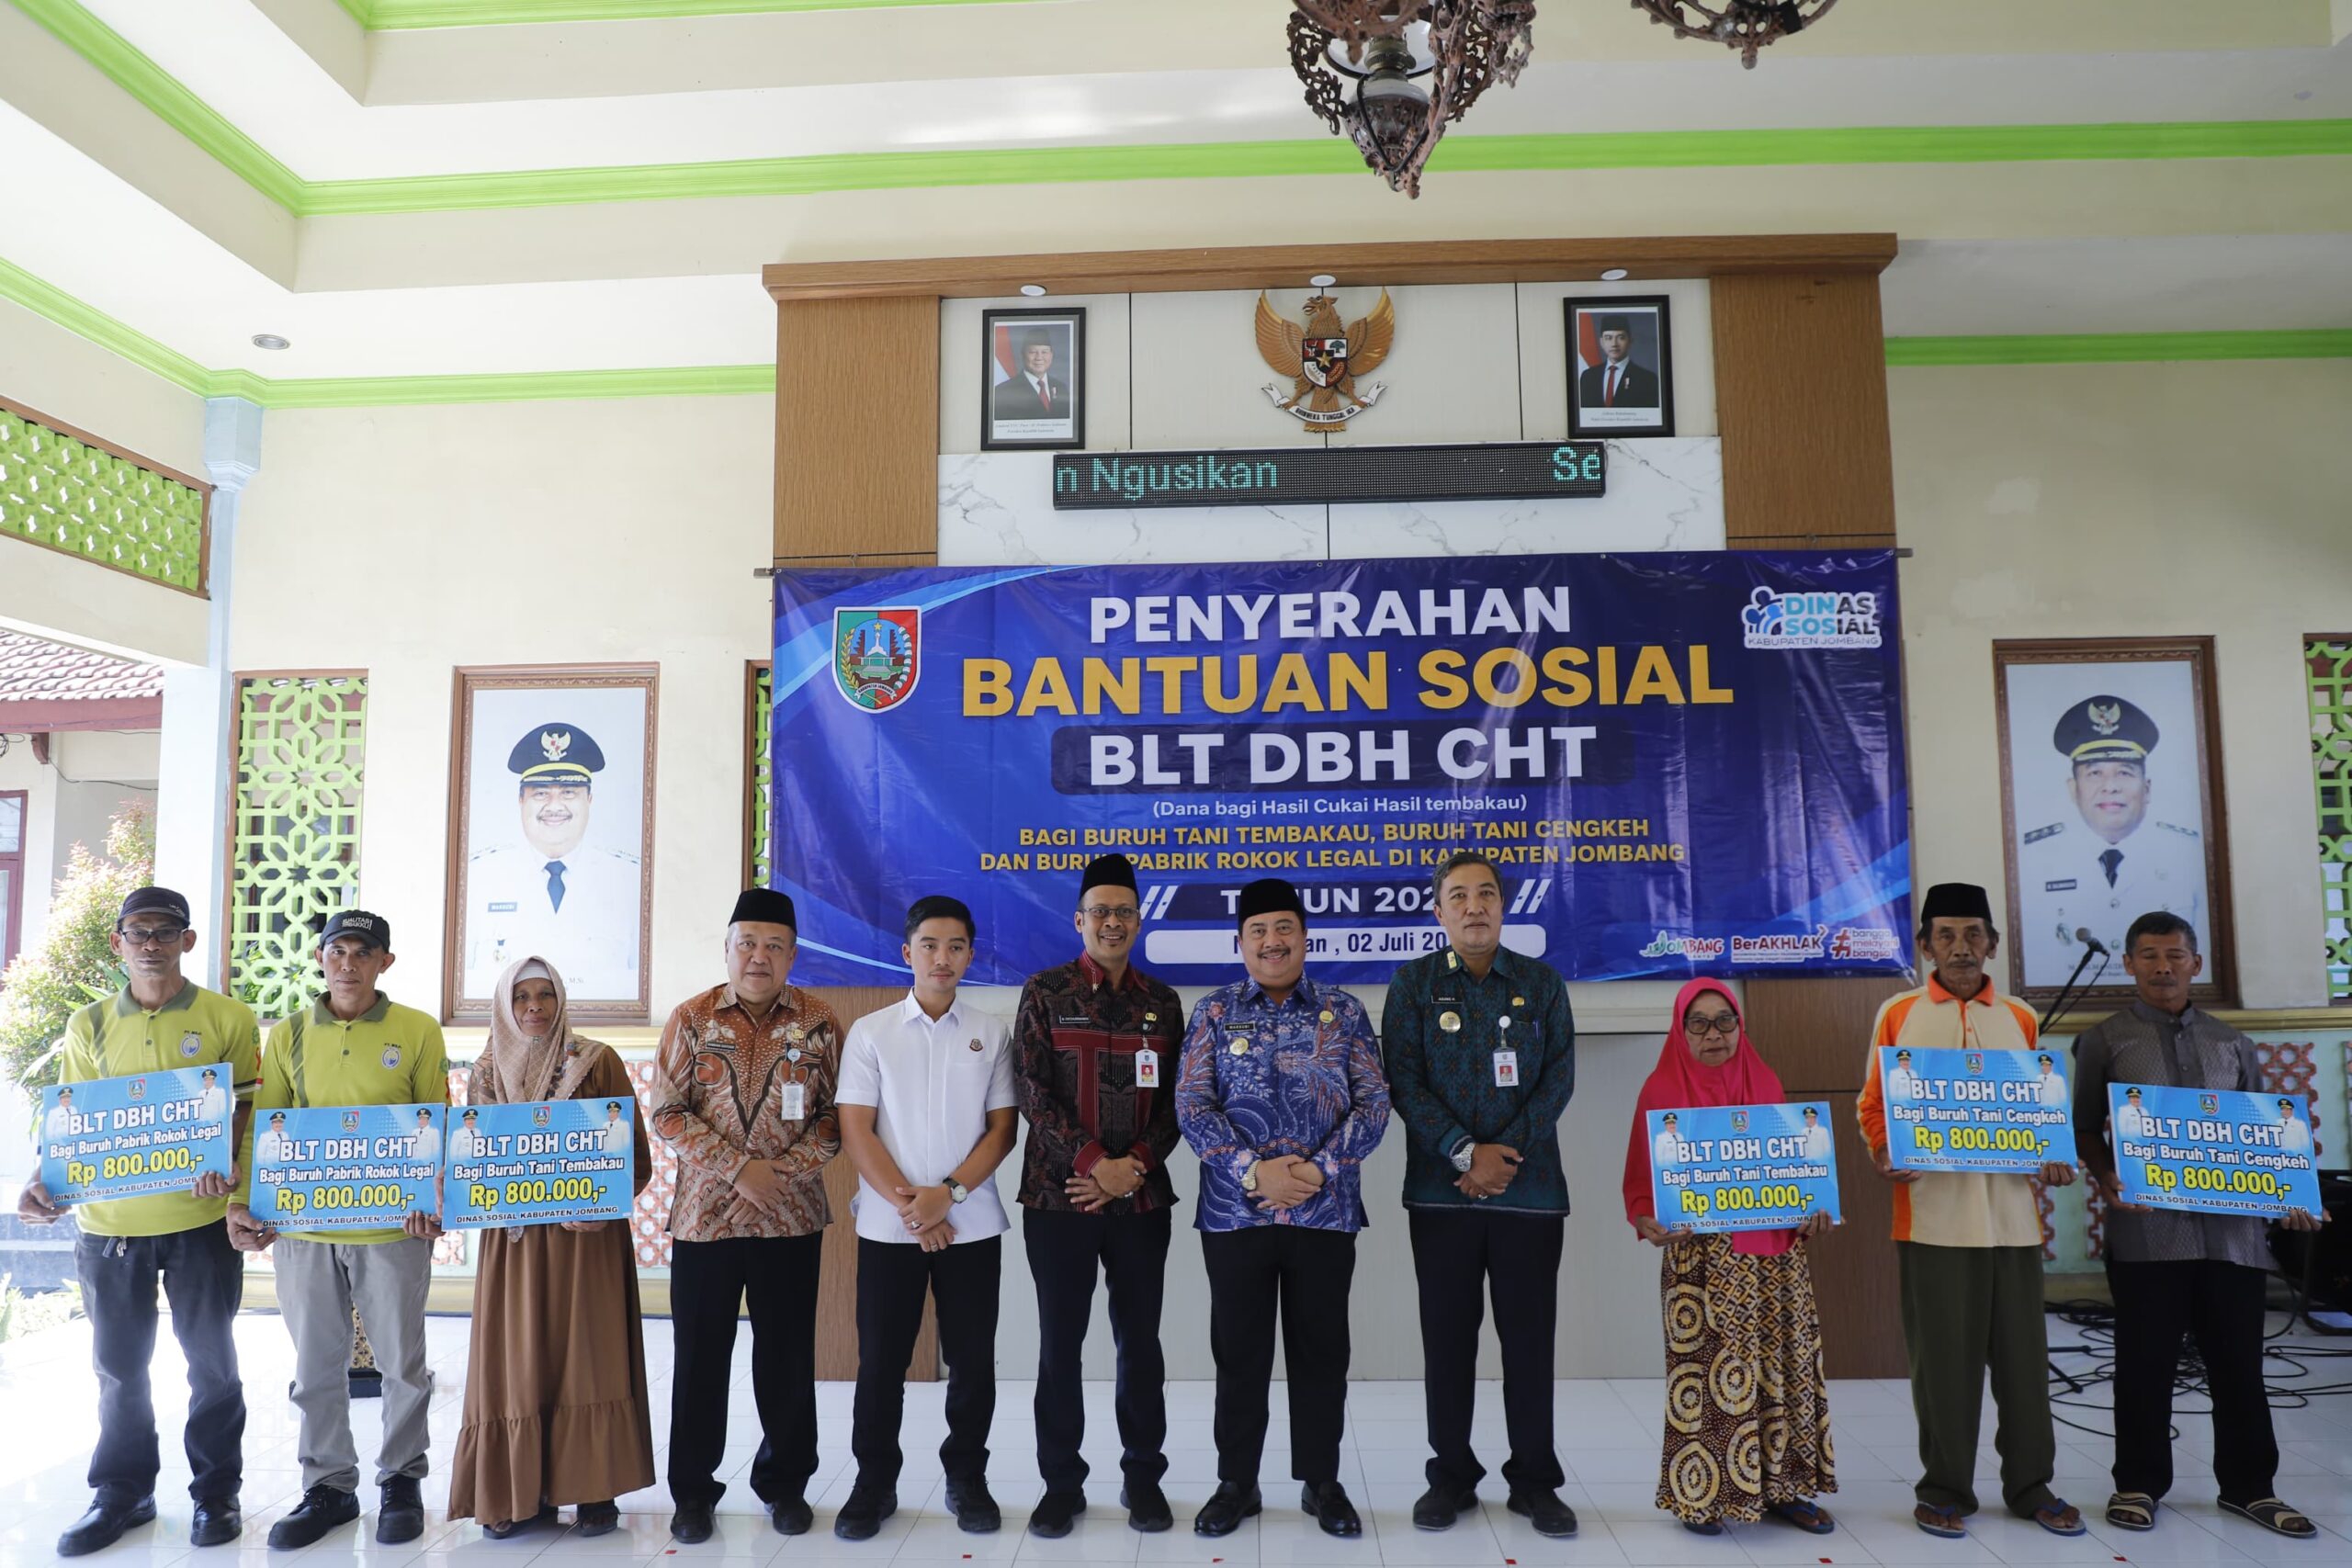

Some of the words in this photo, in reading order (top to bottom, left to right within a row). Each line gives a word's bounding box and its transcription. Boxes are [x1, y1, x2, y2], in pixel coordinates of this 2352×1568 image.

[1093, 455, 1278, 501] Ngusikan
[1091, 586, 1571, 643] PENYERAHAN
[1785, 596, 1872, 615] DINAS
[1785, 617, 1876, 636] SOSIAL
[1748, 637, 1818, 647] KABUPATEN
[1821, 637, 1879, 646] JOMBANG
[963, 650, 1388, 717] BANTUAN
[1418, 645, 1735, 709] SOSIAL
[1091, 733, 1225, 785] BLT
[1250, 729, 1410, 784] DBH
[1437, 726, 1597, 780] CHT
[1153, 801, 1210, 818] (Dana
[1216, 800, 1257, 818] bagi
[1262, 798, 1309, 815] Hasil
[1314, 797, 1369, 814] Cukai
[1374, 795, 1420, 813] Hasil
[1425, 795, 1527, 812] tembakau)
[1020, 829, 1076, 846] BAGI
[1084, 828, 1166, 845] BURUH
[1174, 827, 1228, 844] TANI
[1236, 824, 1376, 844] TEMBAKAU,
[1384, 822, 1465, 841] BURUH
[1472, 821, 1528, 840] TANI
[1534, 819, 1649, 838] CENGKEH
[980, 853, 1029, 871] DAN
[1217, 852, 1298, 869] ROKOK
[1306, 849, 1381, 868] LEGAL
[1389, 848, 1411, 866] DI
[1566, 843, 1684, 863] JOMBANG
[1220, 887, 1360, 914] TUN
[1348, 933, 1373, 953] 02
[1379, 931, 1414, 952] Juli
[1733, 937, 1822, 950] BerAKHLAK
[1910, 1078, 1947, 1100] BLT
[1953, 1079, 1996, 1102] DBH
[2001, 1080, 2042, 1104] CHT
[69, 1110, 107, 1135] BLT
[113, 1104, 155, 1130] DBH
[162, 1098, 203, 1123] CHT
[1893, 1104, 1924, 1122] Bagi
[1928, 1105, 1970, 1122] Buruh
[1973, 1107, 2002, 1122] Tani
[2006, 1108, 2066, 1127] Cengkeh
[50, 1142, 75, 1160] Bagi
[79, 1137, 111, 1155] Buruh
[115, 1131, 151, 1150] Pabrik
[153, 1127, 187, 1145] Rokok
[190, 1122, 221, 1142] Legal
[472, 1135, 511, 1158] BLT
[516, 1133, 560, 1156] DBH
[565, 1129, 608, 1152] CHT
[1914, 1126, 1943, 1154] Rp
[1949, 1127, 2050, 1157] 800.000,-
[2141, 1116, 2180, 1139] BLT
[2188, 1120, 2233, 1144] DBH
[2238, 1123, 2283, 1147] CHT
[279, 1140, 320, 1161] BLT
[324, 1138, 368, 1160] DBH
[374, 1135, 417, 1158] CHT
[1677, 1140, 1713, 1163] BLT
[1719, 1138, 1762, 1161] DBH
[1767, 1135, 1807, 1159] CHT
[1905, 1156, 1931, 1165] DINAS
[1934, 1157, 1964, 1166] SOSIAL
[1967, 1158, 2018, 1167] KABUPATEN
[2122, 1141, 2156, 1160] Bagi
[2160, 1145, 2204, 1162] Buruh
[2207, 1148, 2239, 1165] Tani
[2244, 1150, 2310, 1170] Cengkeh
[67, 1161, 96, 1187] Rp
[103, 1147, 204, 1179] 800.000,-
[259, 1168, 286, 1185] Bagi
[288, 1167, 322, 1182] Buruh
[325, 1165, 362, 1180] Pabrik
[365, 1164, 400, 1179] Rokok
[402, 1162, 435, 1180] Legal
[453, 1164, 483, 1181] Bagi
[486, 1161, 525, 1178] Buruh
[527, 1159, 555, 1175] Tani
[559, 1156, 625, 1173] Tembakau
[1662, 1169, 1690, 1187] Bagi
[1693, 1168, 1731, 1184] Buruh
[1734, 1166, 1760, 1182] Tani
[1763, 1163, 1828, 1179] Tembakau
[54, 1192, 82, 1201] DINAS
[85, 1188, 116, 1198] SOSIAL
[119, 1179, 170, 1192] KABUPATEN
[173, 1176, 201, 1185] JOMB
[469, 1184, 499, 1211] Rp
[505, 1177, 607, 1203] 800.000,-
[2145, 1163, 2177, 1192] Rp
[2183, 1166, 2291, 1201] 800.000,-
[276, 1188, 306, 1215] Rp
[312, 1184, 415, 1211] 800.000,-
[520, 1210, 572, 1219] KABUPATEN
[575, 1206, 617, 1215] JOMBANG
[1680, 1190, 1710, 1217] Rp
[1715, 1184, 1814, 1212] 800.000,-
[2136, 1193, 2164, 1202] DINAS
[2166, 1196, 2199, 1205] SOSIAL
[2202, 1200, 2257, 1210] KABUPATEN
[263, 1219, 290, 1227] DINAS
[327, 1215, 379, 1224] KABUPATEN
[1672, 1221, 1698, 1229] DINAS
[1733, 1217, 1783, 1225] KABUPATEN
